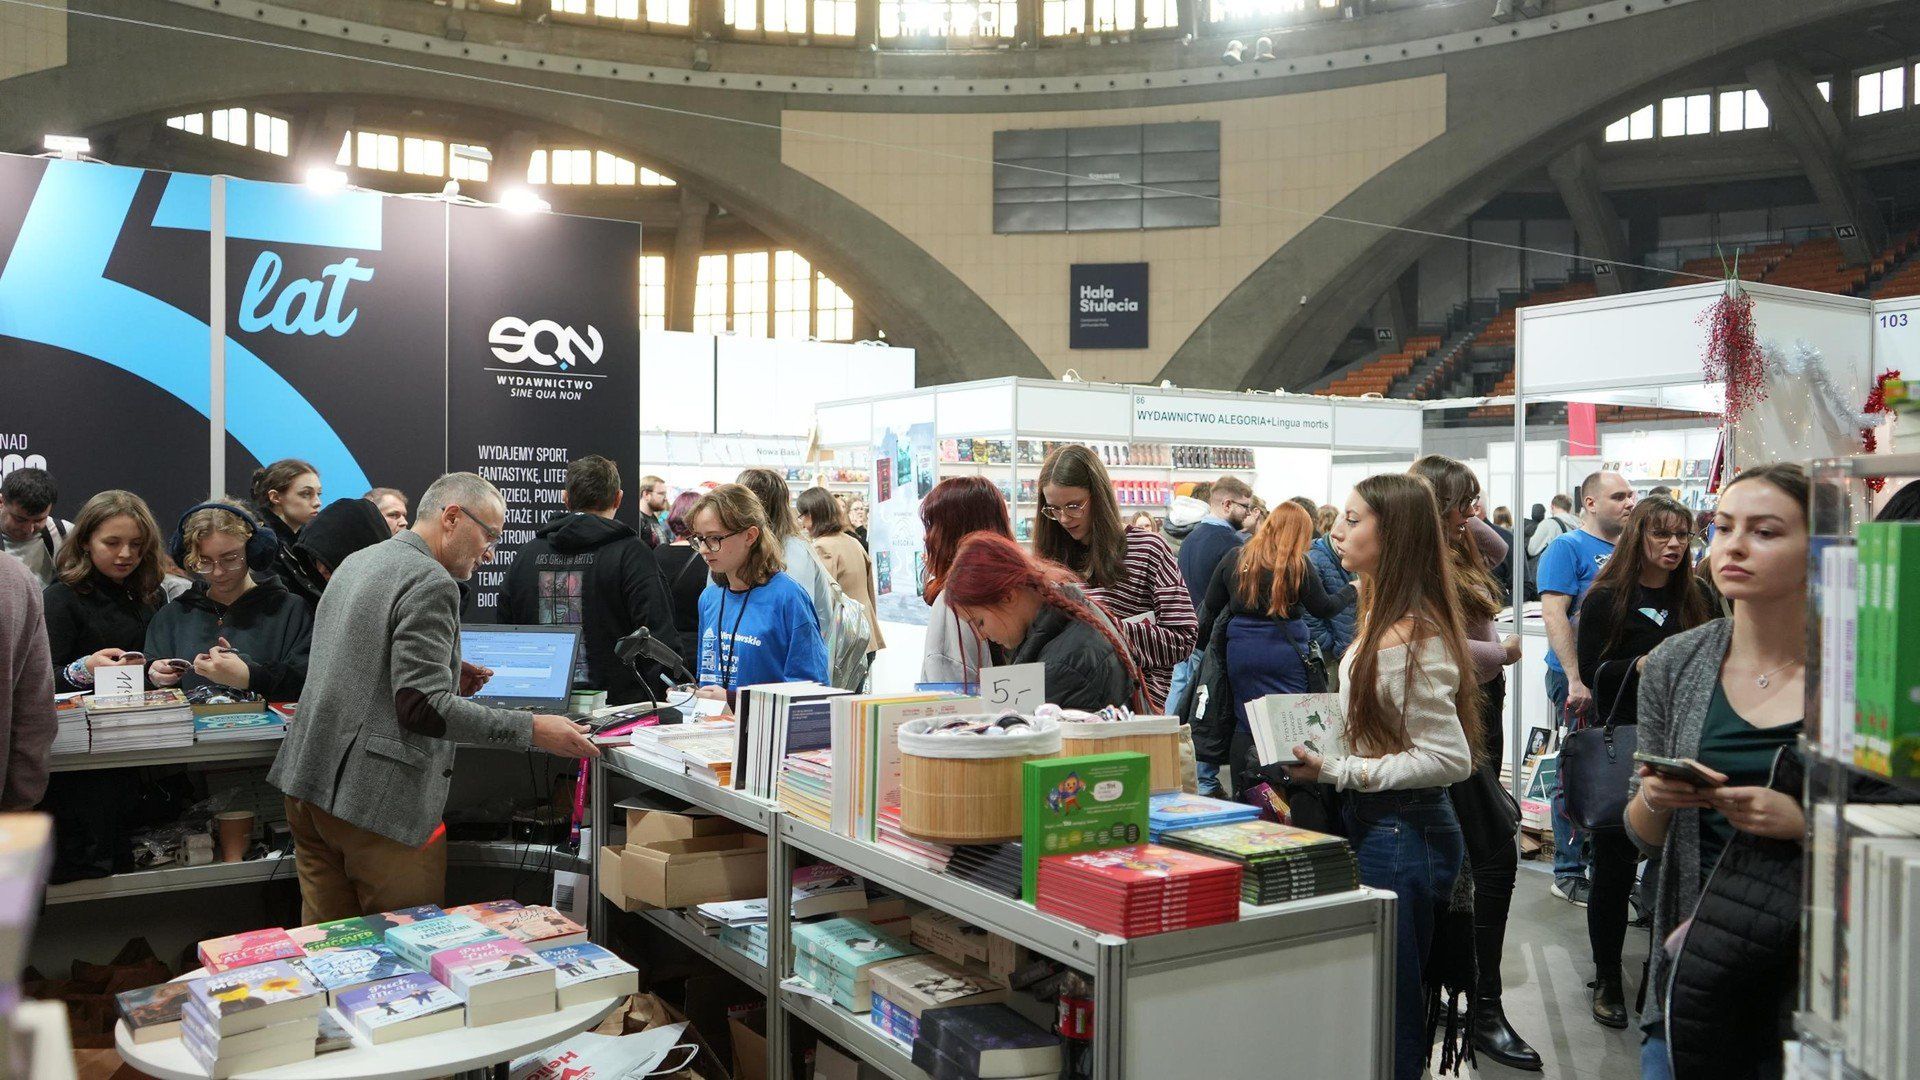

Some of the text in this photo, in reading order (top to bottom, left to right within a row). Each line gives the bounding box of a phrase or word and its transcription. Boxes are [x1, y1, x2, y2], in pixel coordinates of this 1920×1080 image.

[238, 250, 374, 338] lat
[1080, 285, 1114, 298] Hala
[1080, 298, 1138, 312] Stulecia
[1880, 313, 1908, 328] 103
[488, 316, 604, 367] SQN
[496, 375, 594, 390] WYDAWNICTWO
[510, 388, 582, 401] SINE QUA NON
[1135, 396, 1146, 405] 86
[1137, 410, 1216, 424] WYDAWNICTWO
[1303, 420, 1329, 430] mortis
[478, 445, 569, 463] WYDAJEMY SPORT,
[478, 466, 541, 484] FANTASTYKĘ,
[500, 488, 532, 504] DZIECI,
[308, 930, 374, 952] UNCOVER
[459, 943, 498, 956] Puck
[541, 947, 580, 958] Puck
[369, 978, 411, 994] Puck
